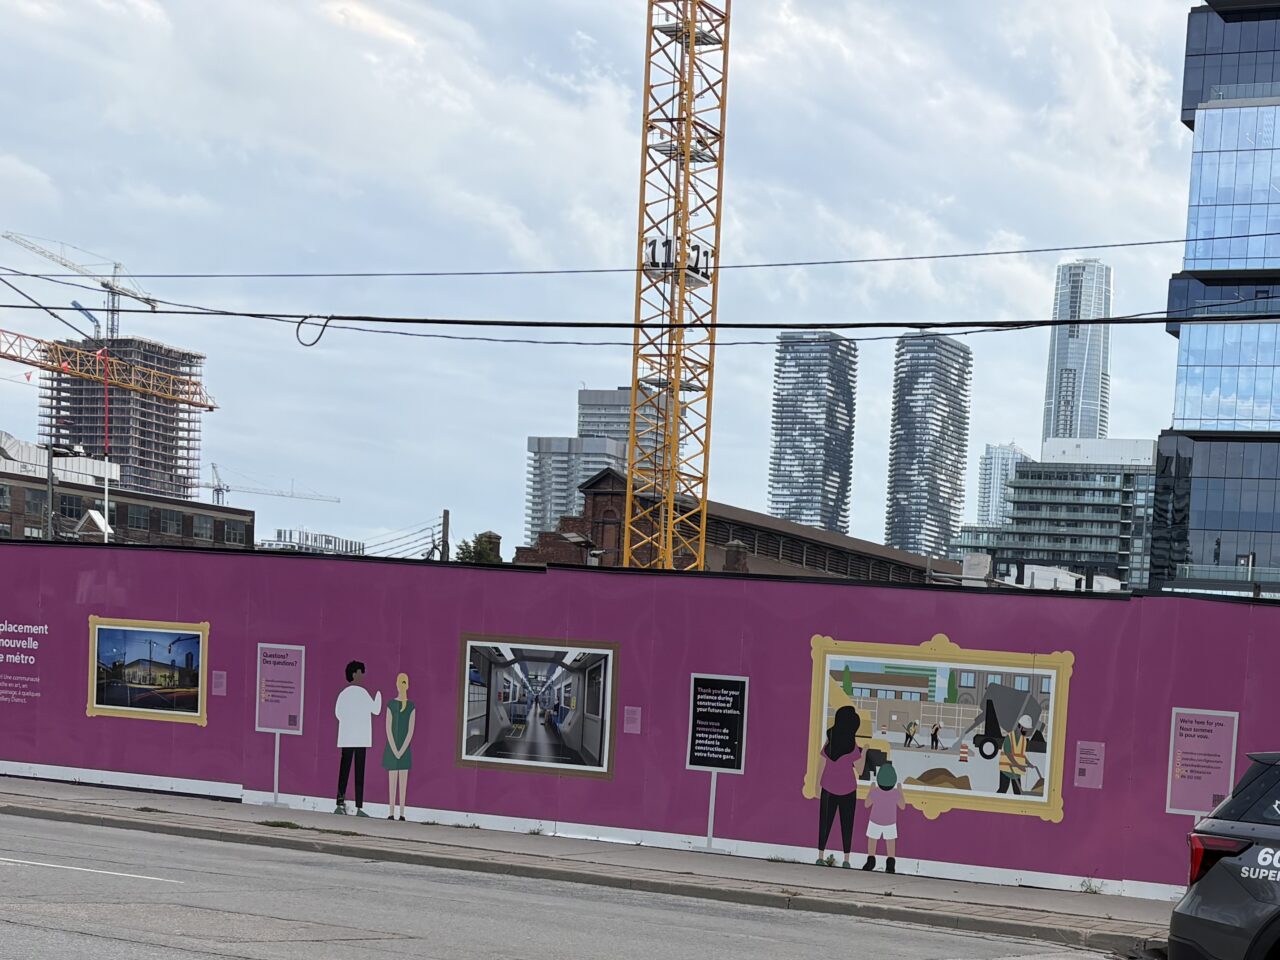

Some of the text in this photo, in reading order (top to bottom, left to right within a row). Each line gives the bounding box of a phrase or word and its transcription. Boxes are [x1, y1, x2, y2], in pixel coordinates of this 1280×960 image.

[649, 239, 674, 268] 11
[0, 637, 39, 649] nouvelle
[6, 652, 35, 665] métro
[263, 652, 289, 660] Questions?
